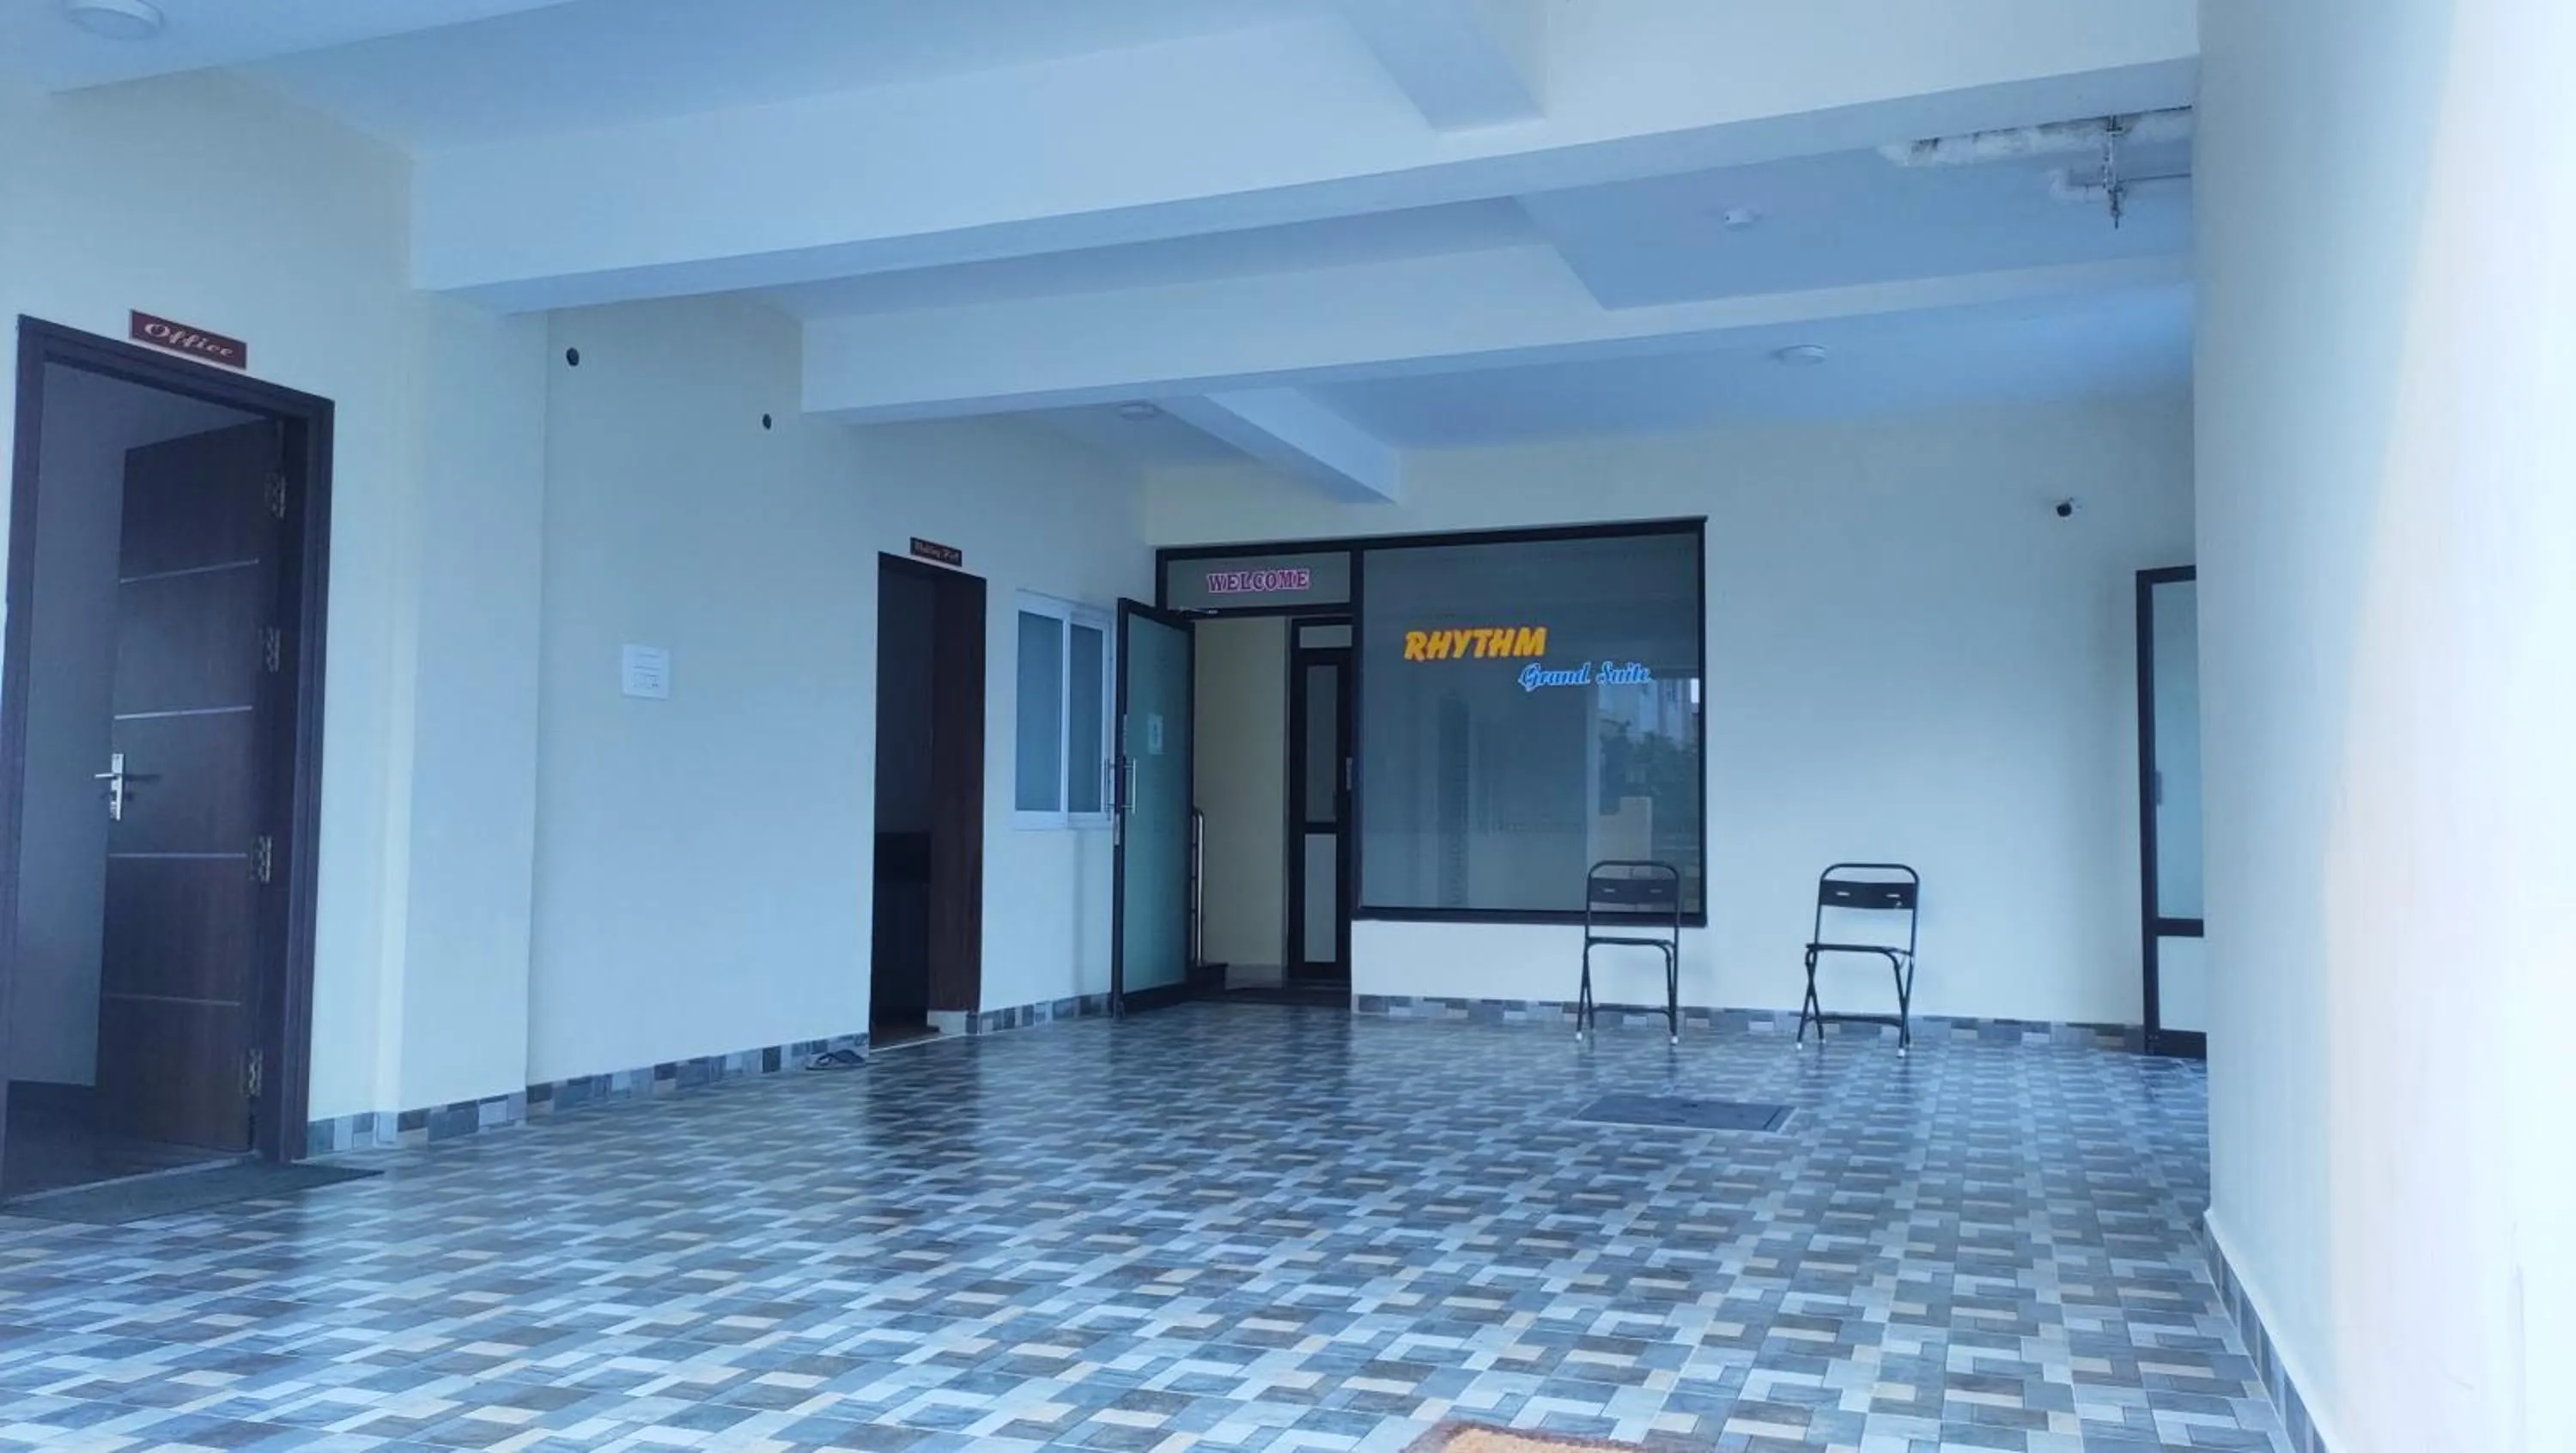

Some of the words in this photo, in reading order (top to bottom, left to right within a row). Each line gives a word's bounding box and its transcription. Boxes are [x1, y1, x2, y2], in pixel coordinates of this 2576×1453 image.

[144, 323, 233, 356] Office
[1207, 569, 1309, 593] WELCOME
[1403, 627, 1548, 661] RHYTHM
[1518, 662, 1591, 692] Grand
[1595, 660, 1652, 686] Suite
